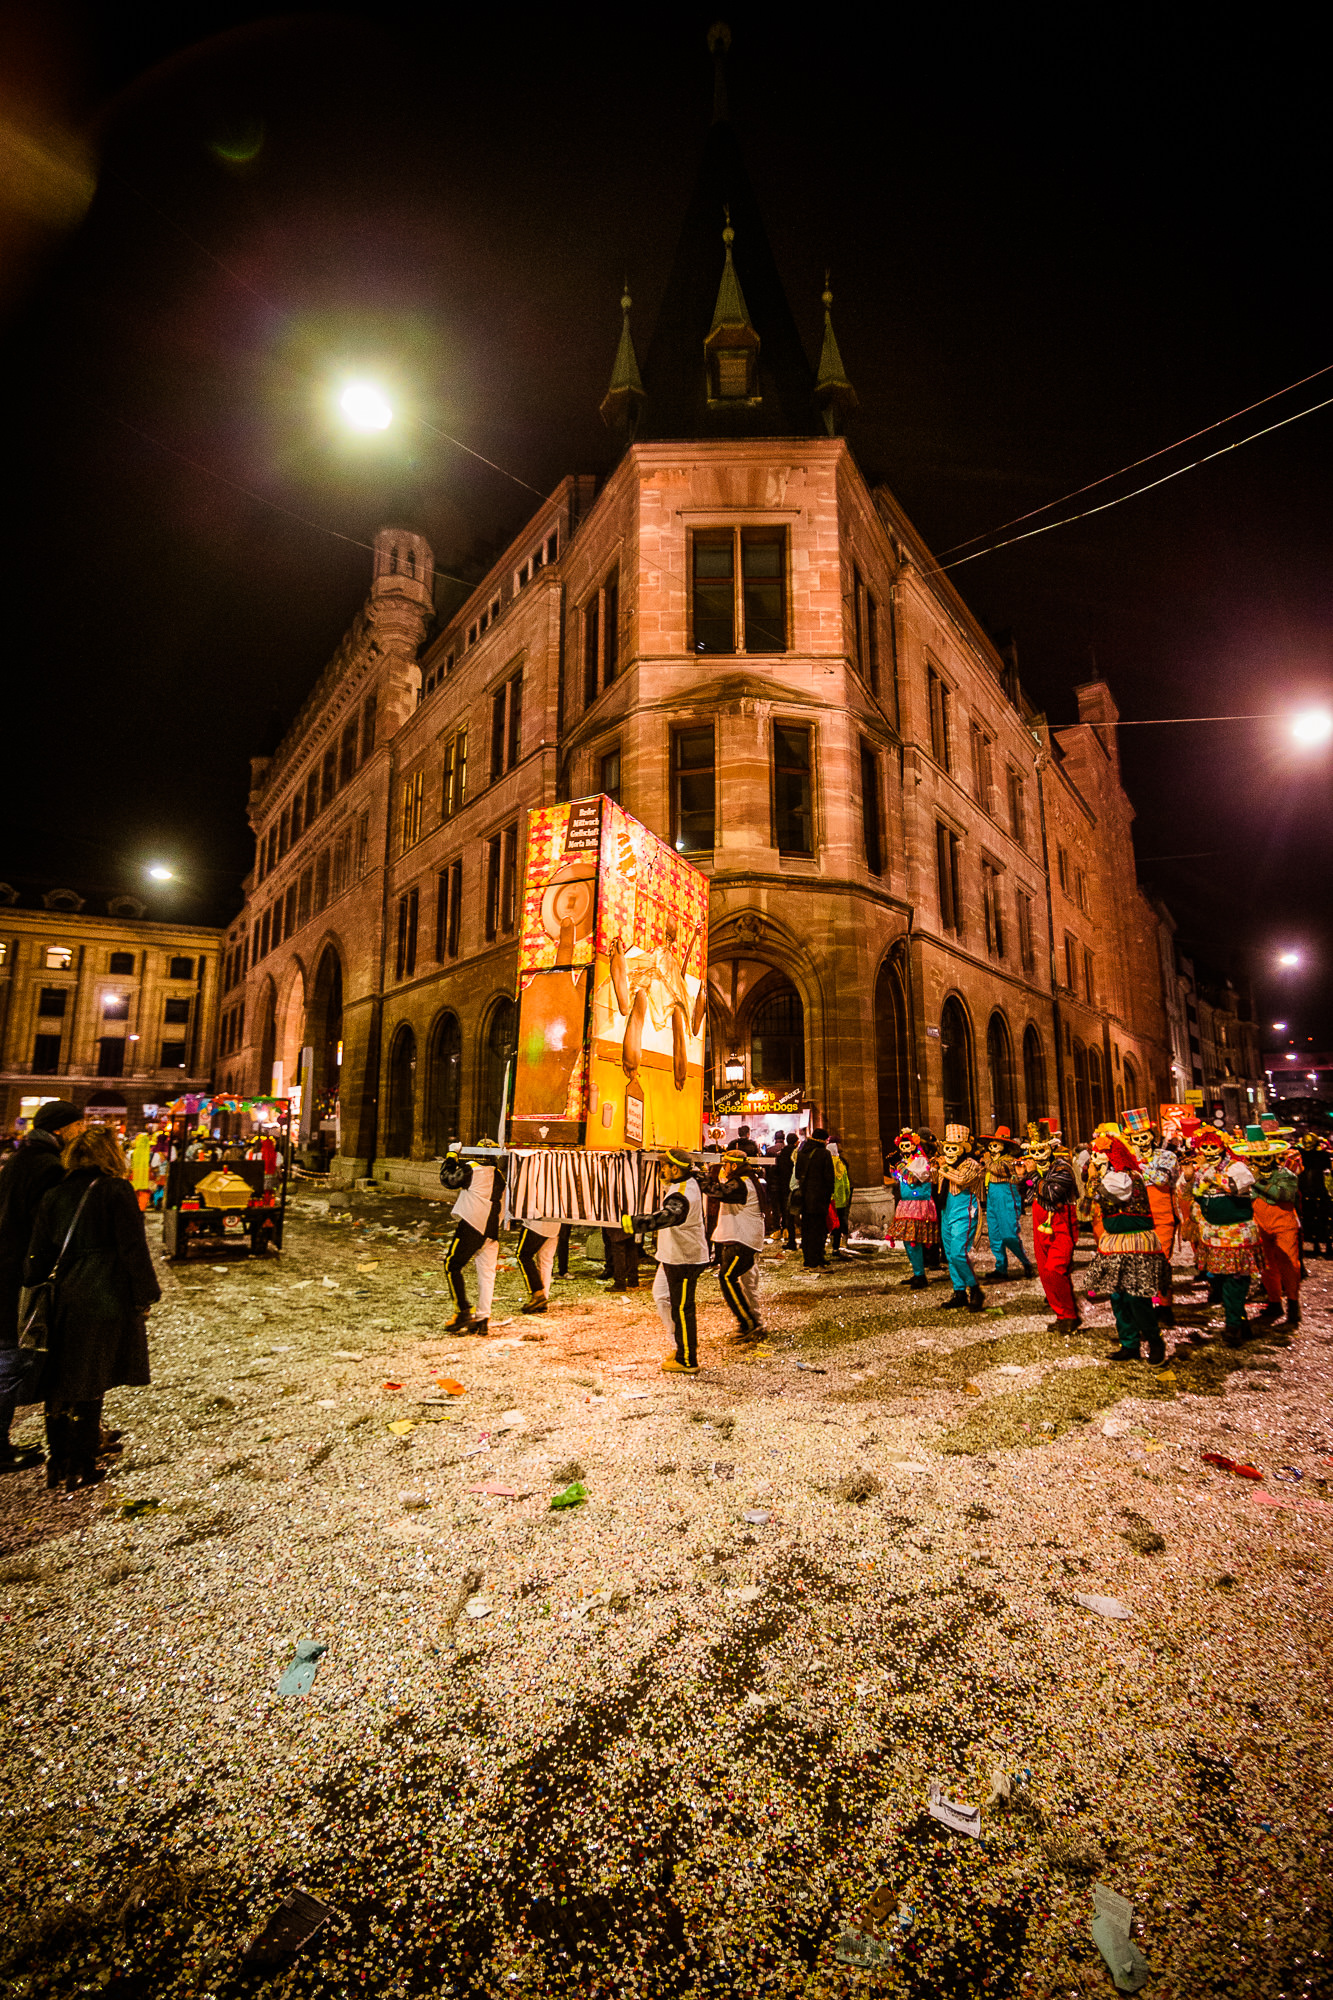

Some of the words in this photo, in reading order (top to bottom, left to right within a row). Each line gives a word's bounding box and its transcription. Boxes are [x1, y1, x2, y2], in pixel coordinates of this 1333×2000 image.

[715, 1090, 736, 1105] MERGUEZ
[718, 1103, 751, 1114] Spezial
[753, 1102, 798, 1112] Hot-Dogs
